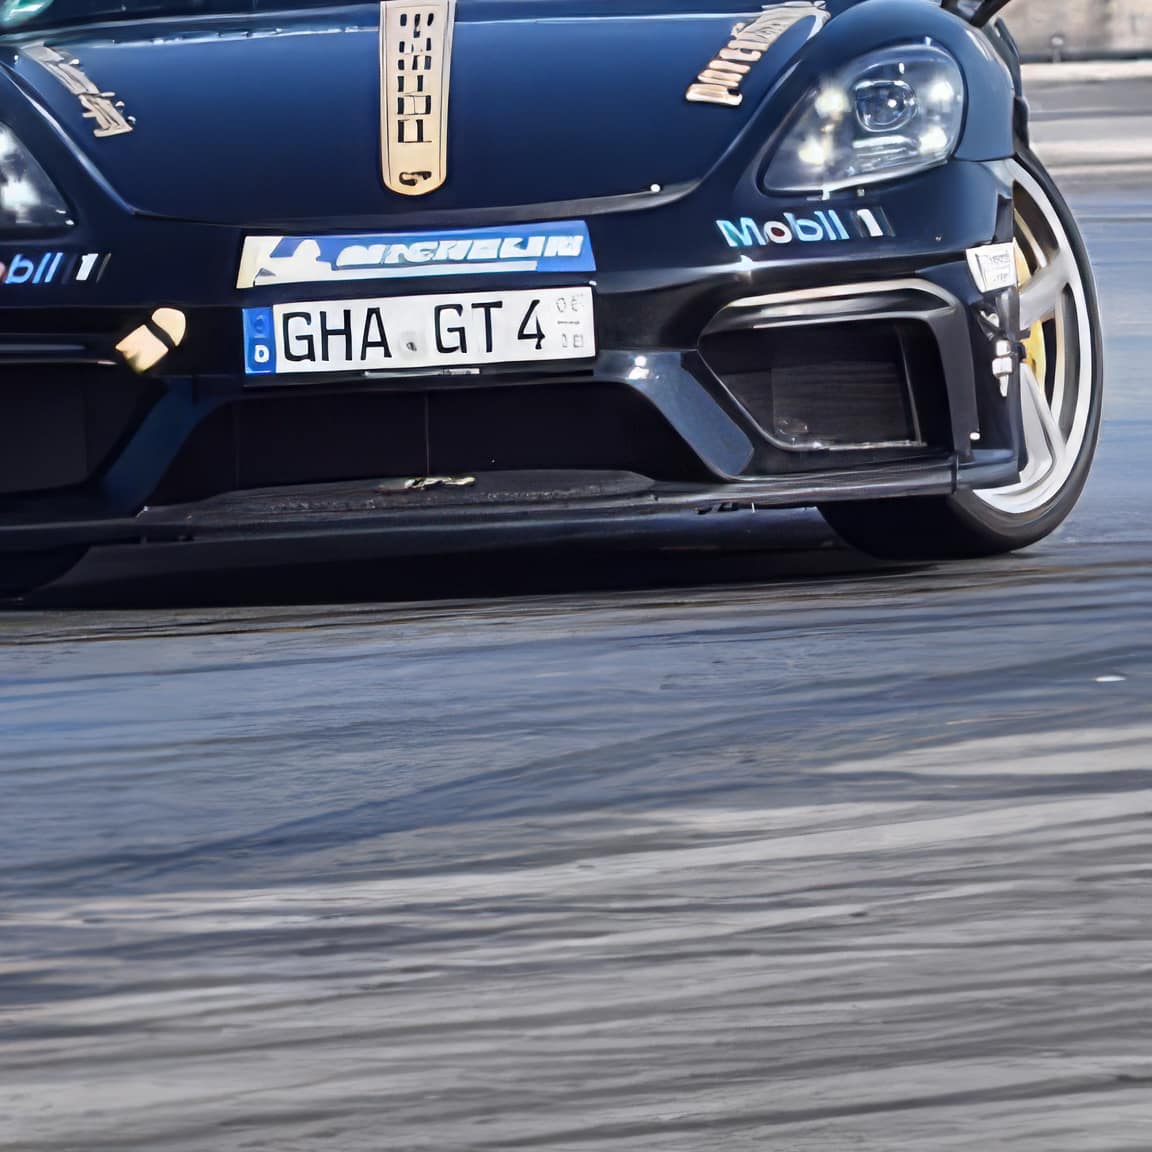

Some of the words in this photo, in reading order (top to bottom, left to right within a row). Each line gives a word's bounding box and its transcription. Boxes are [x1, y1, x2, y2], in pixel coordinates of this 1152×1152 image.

[282, 307, 393, 362] GHA
[434, 301, 503, 355] GT
[517, 299, 546, 350] 4
